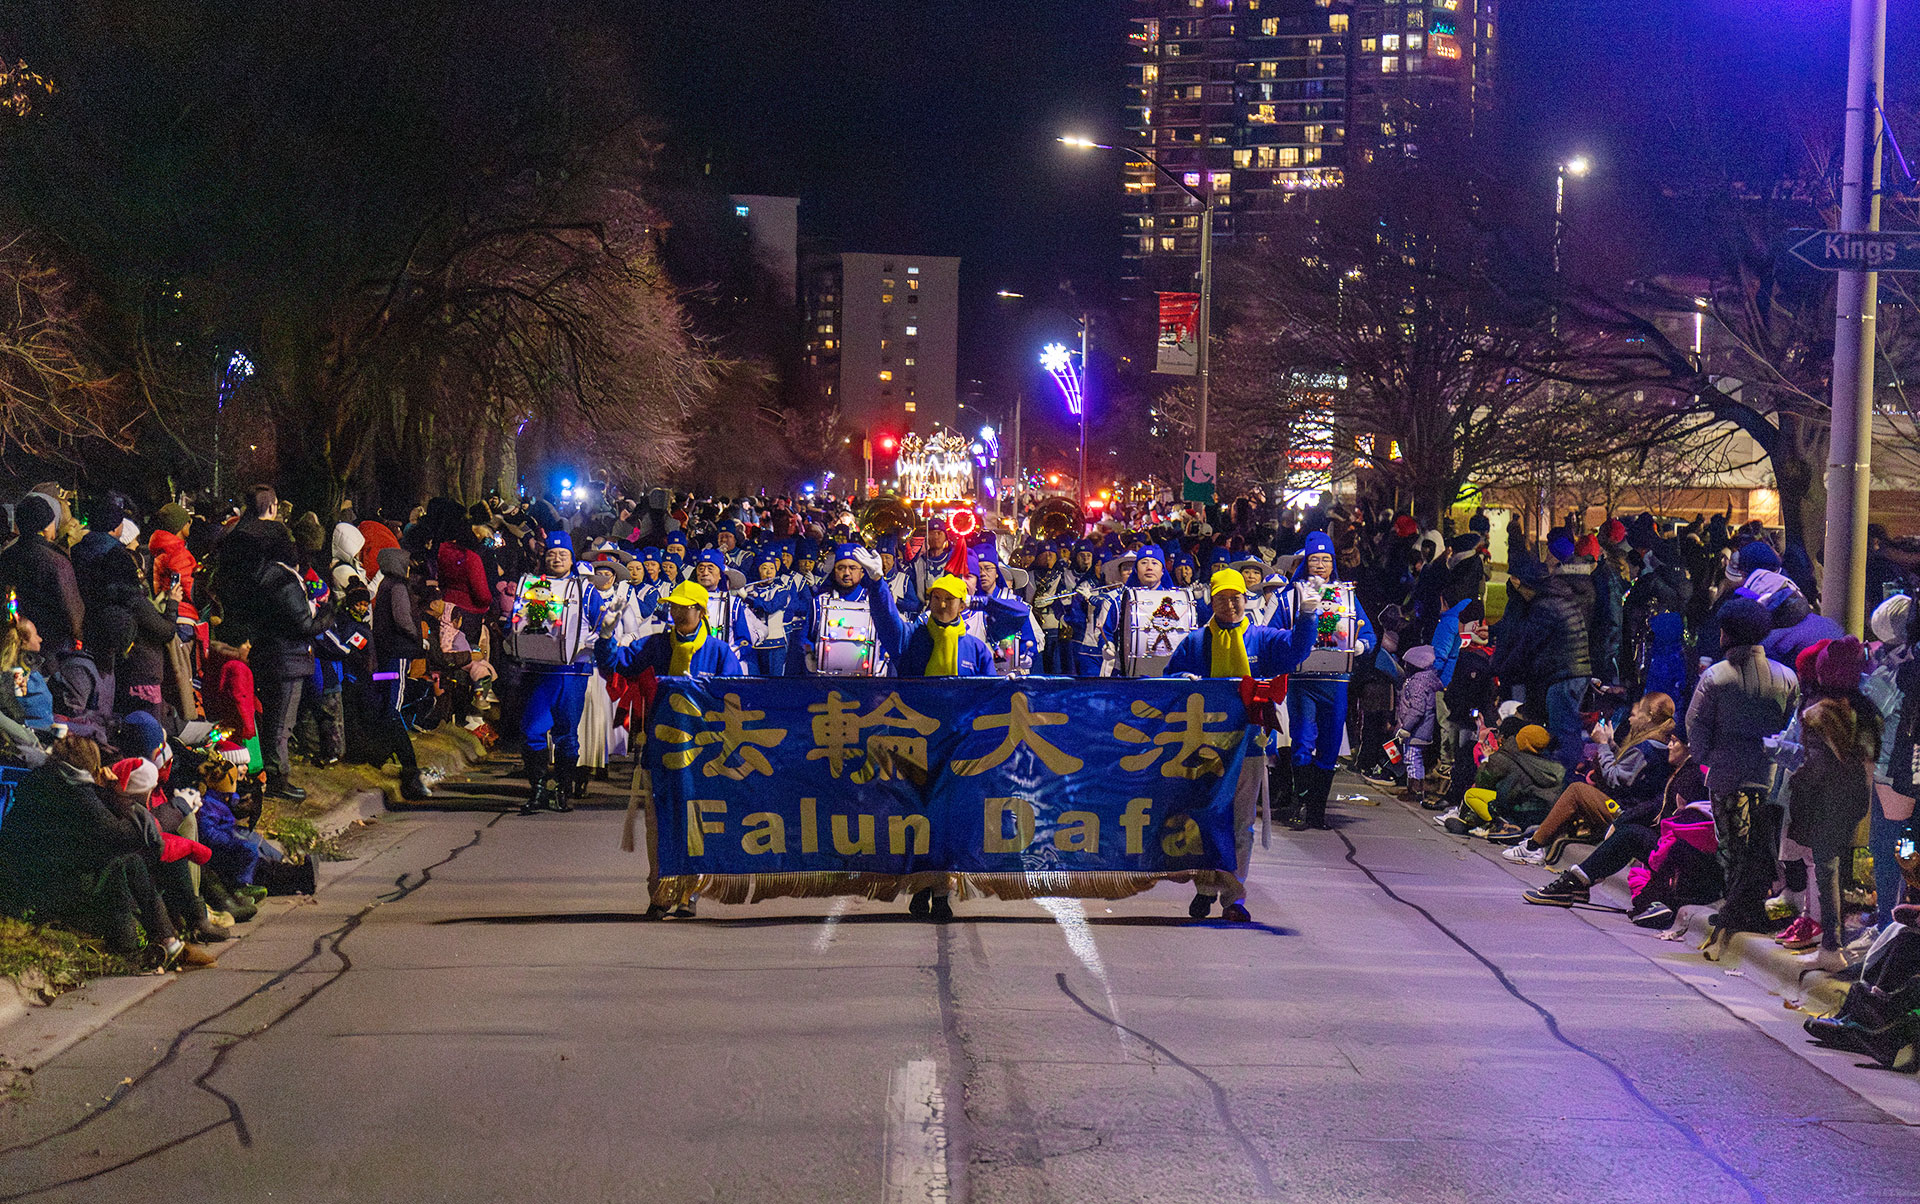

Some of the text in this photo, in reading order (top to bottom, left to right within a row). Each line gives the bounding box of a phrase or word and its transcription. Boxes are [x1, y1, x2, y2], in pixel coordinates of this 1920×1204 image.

[1825, 234, 1896, 265] Kings
[655, 690, 1246, 784] 法輪大法
[687, 797, 1204, 857] Falun Dafa
